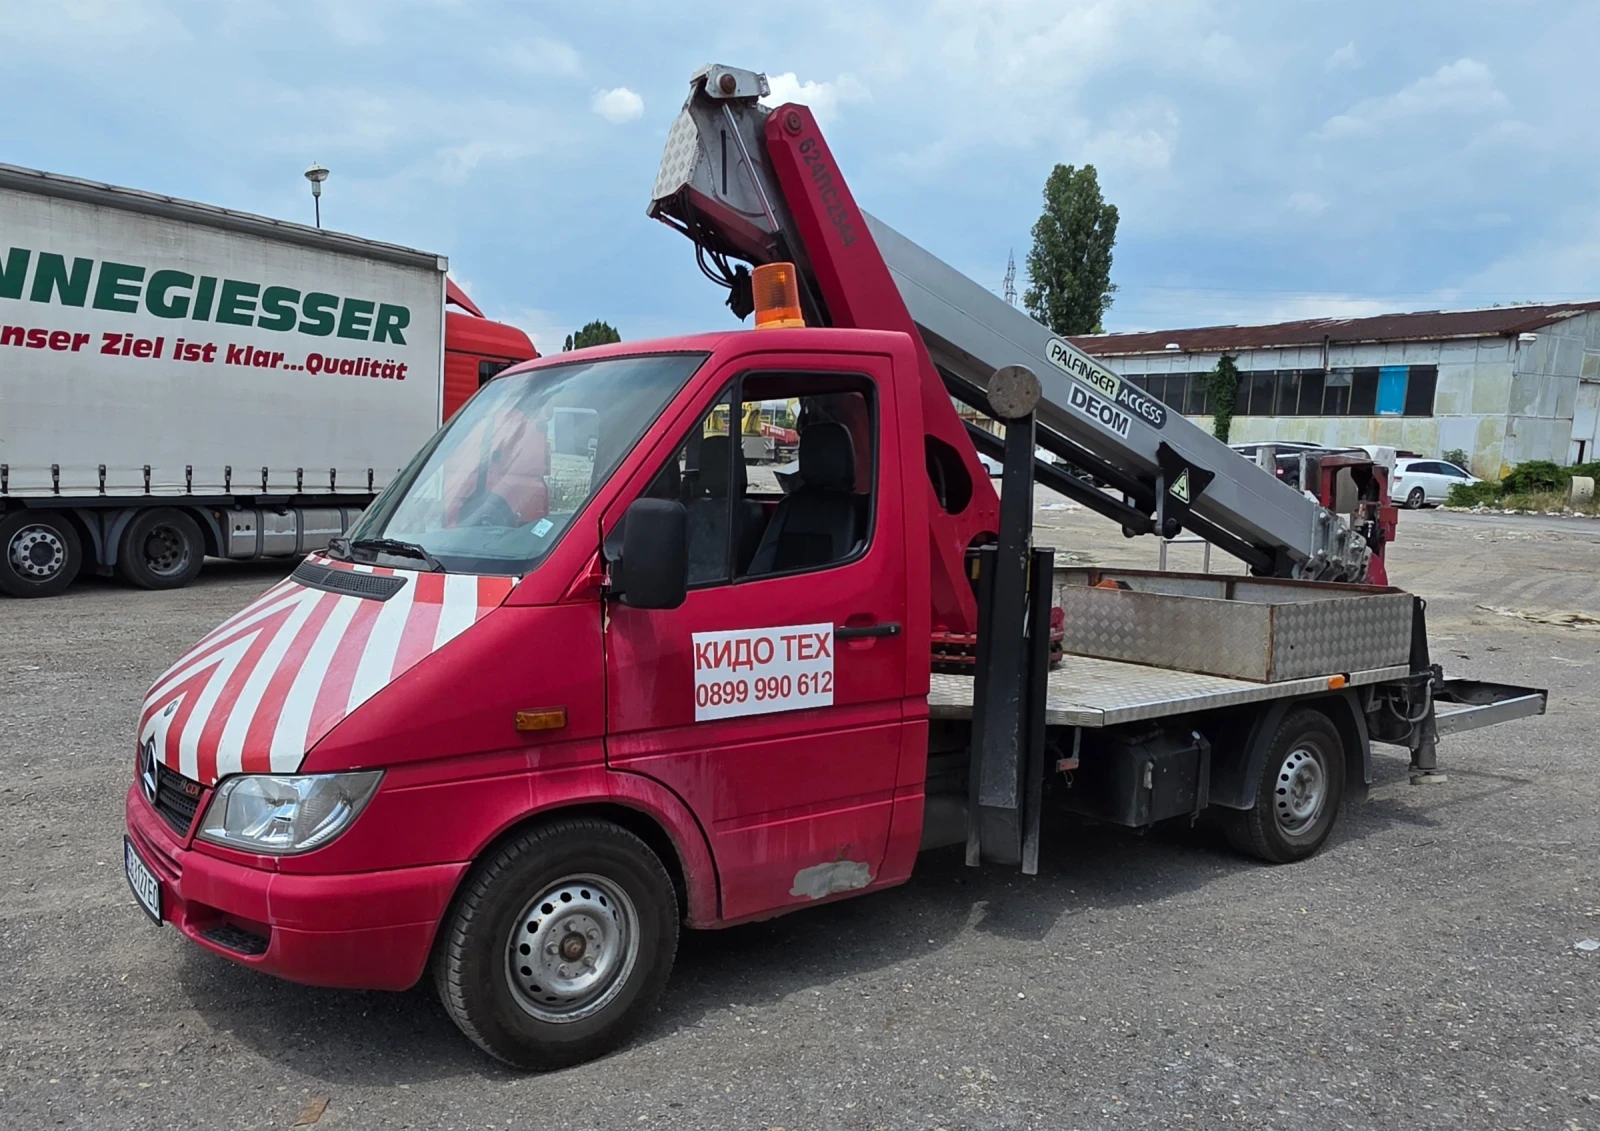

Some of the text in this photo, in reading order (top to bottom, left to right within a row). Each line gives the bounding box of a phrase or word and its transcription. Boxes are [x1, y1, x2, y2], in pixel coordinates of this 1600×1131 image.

[0, 325, 90, 352] nser
[100, 332, 165, 359] Ziel
[173, 338, 218, 364] ist
[1050, 343, 1163, 424] PALFINGER ACCESS
[1070, 386, 1130, 436] DEOM
[695, 637, 774, 672] КИДО
[696, 670, 833, 708] 0899 990 612
